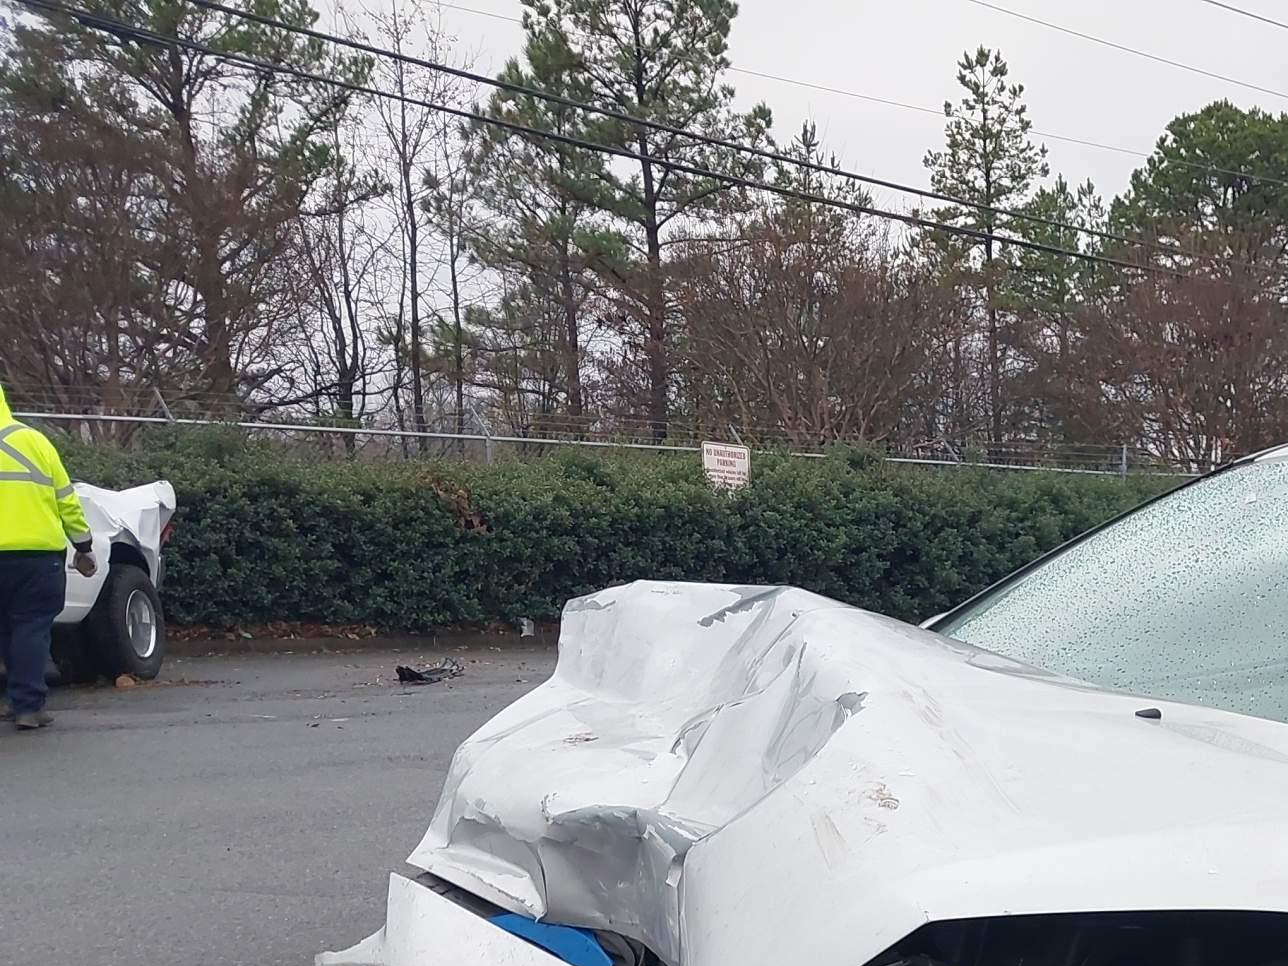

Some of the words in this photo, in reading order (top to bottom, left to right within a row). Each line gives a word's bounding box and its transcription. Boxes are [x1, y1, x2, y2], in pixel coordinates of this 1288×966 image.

[706, 448, 712, 456] NO
[714, 449, 745, 459] UNAUTHORIZED
[717, 458, 736, 467] PARKING
